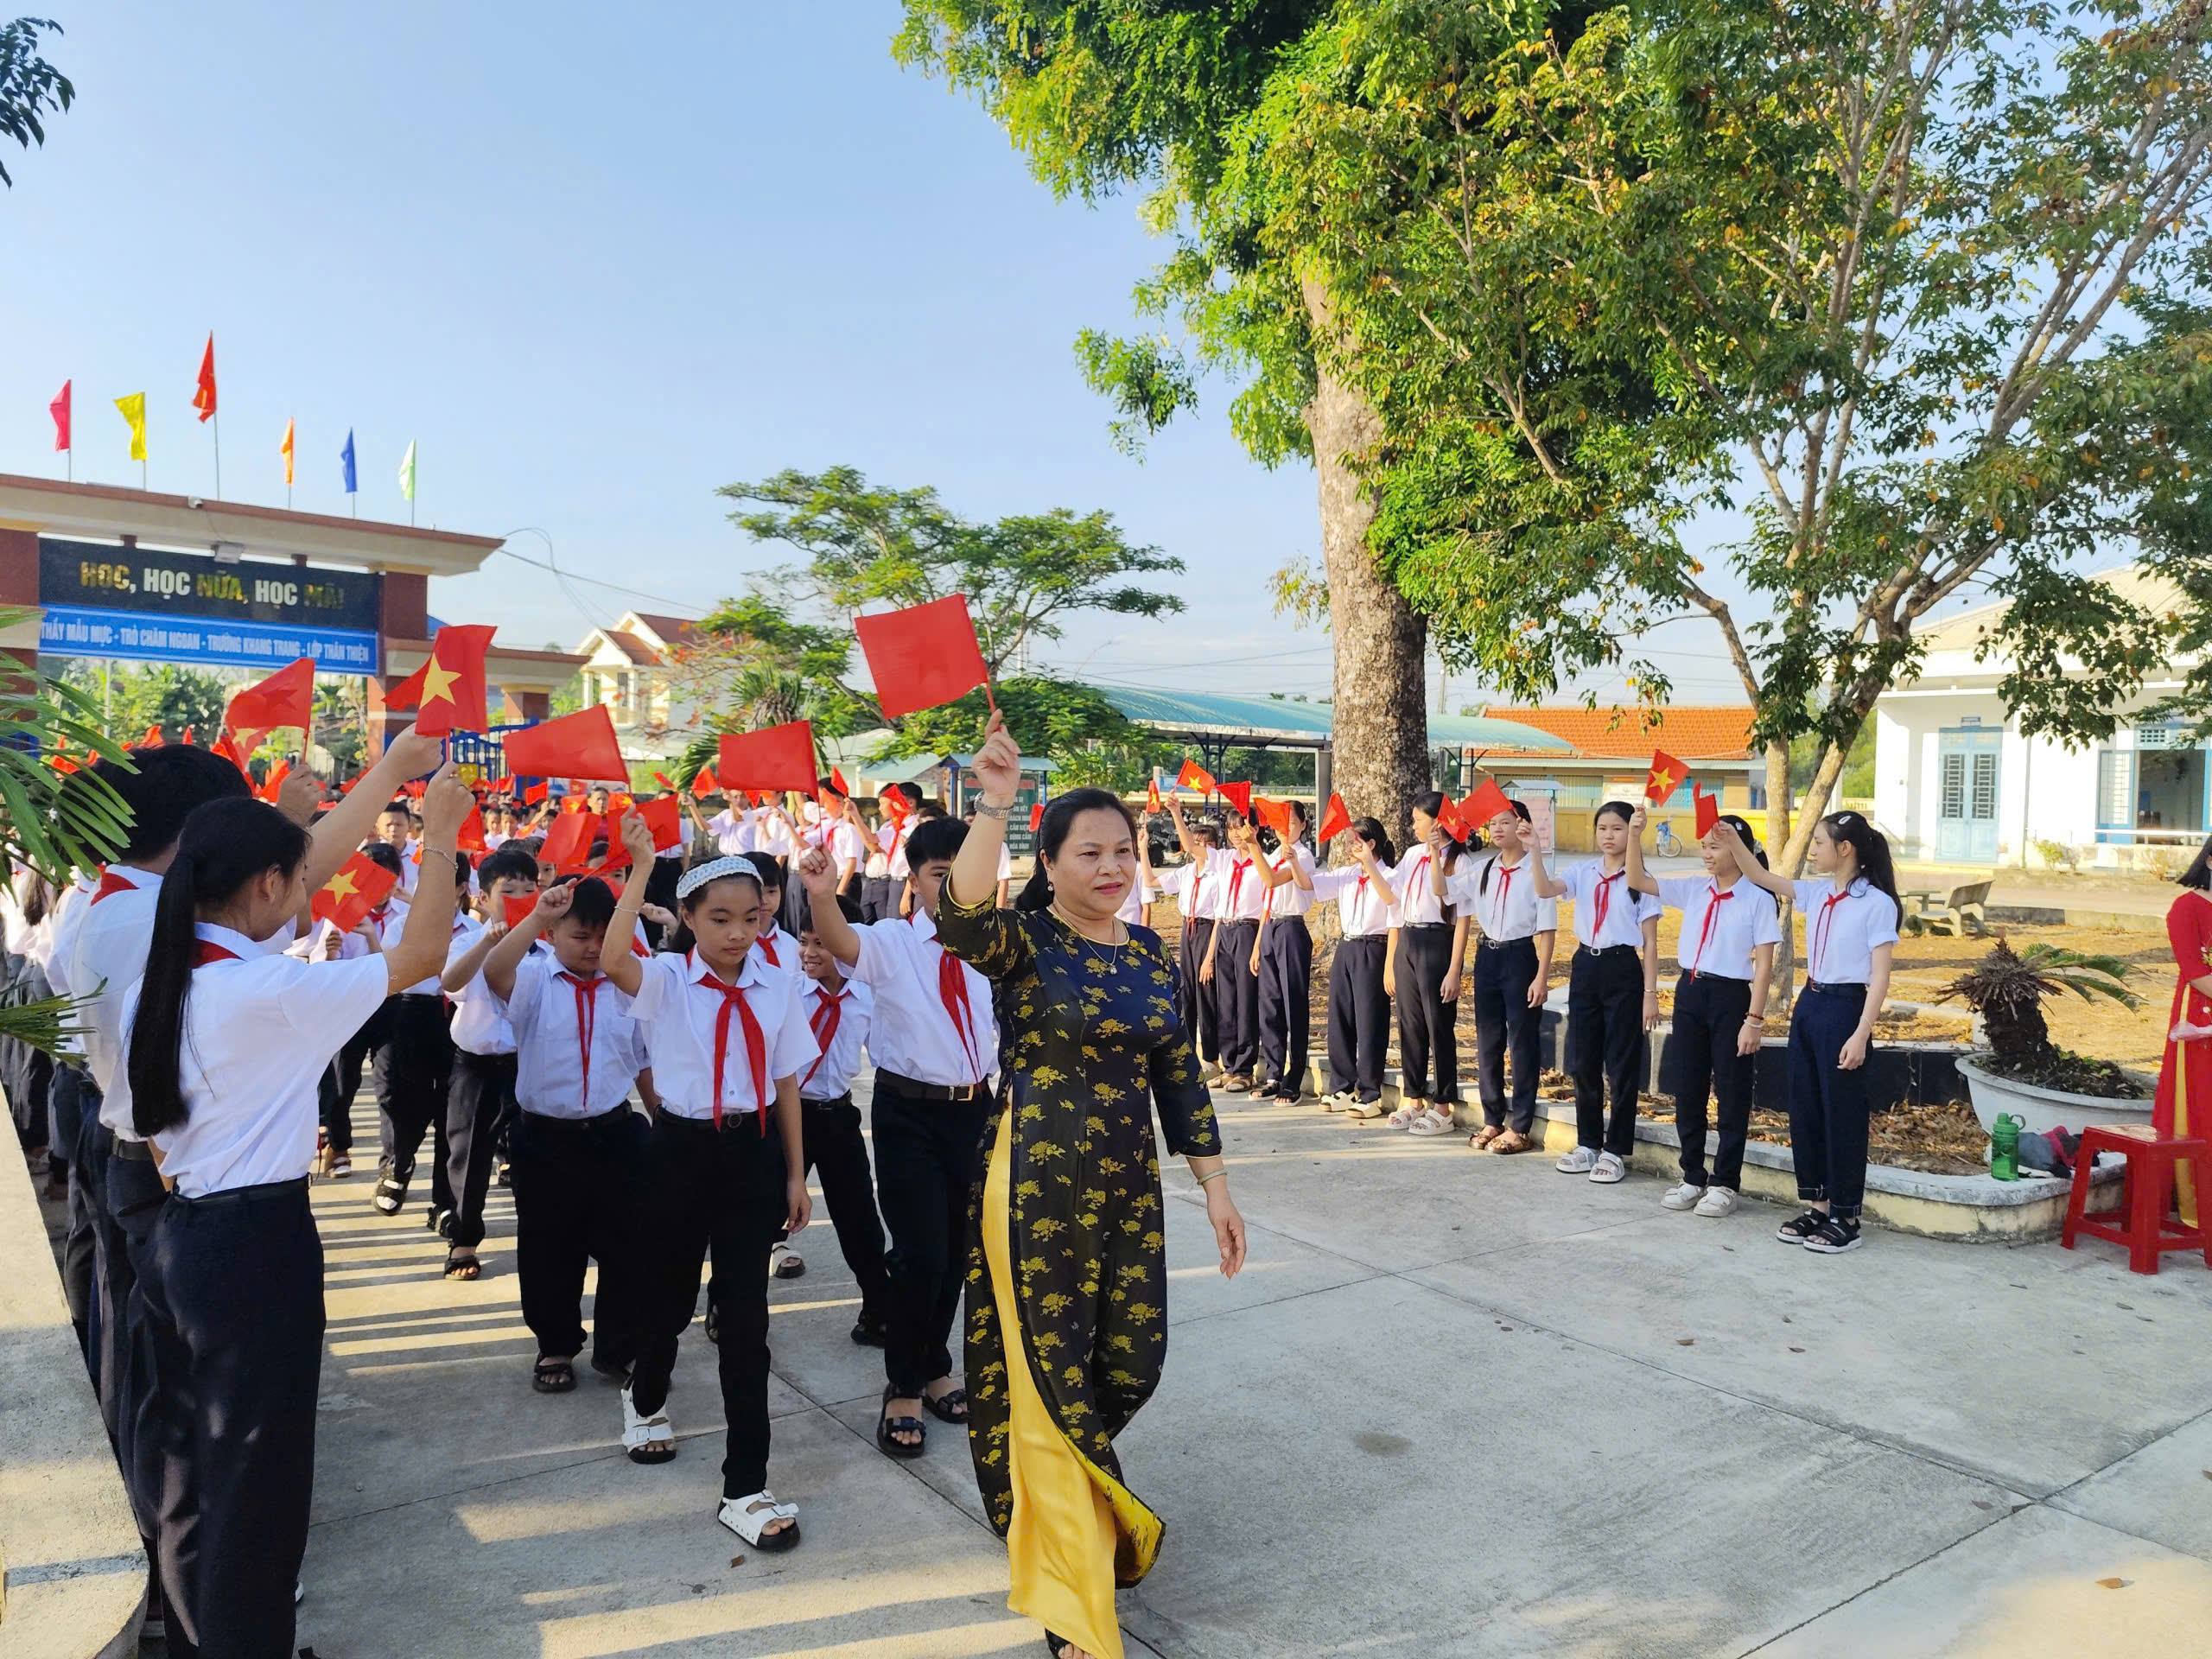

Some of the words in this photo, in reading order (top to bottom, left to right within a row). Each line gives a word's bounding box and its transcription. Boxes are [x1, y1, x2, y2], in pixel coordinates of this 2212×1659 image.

[80, 562, 137, 594] HỌC,
[143, 568, 191, 600] HỌC
[255, 580, 298, 609] HỌC
